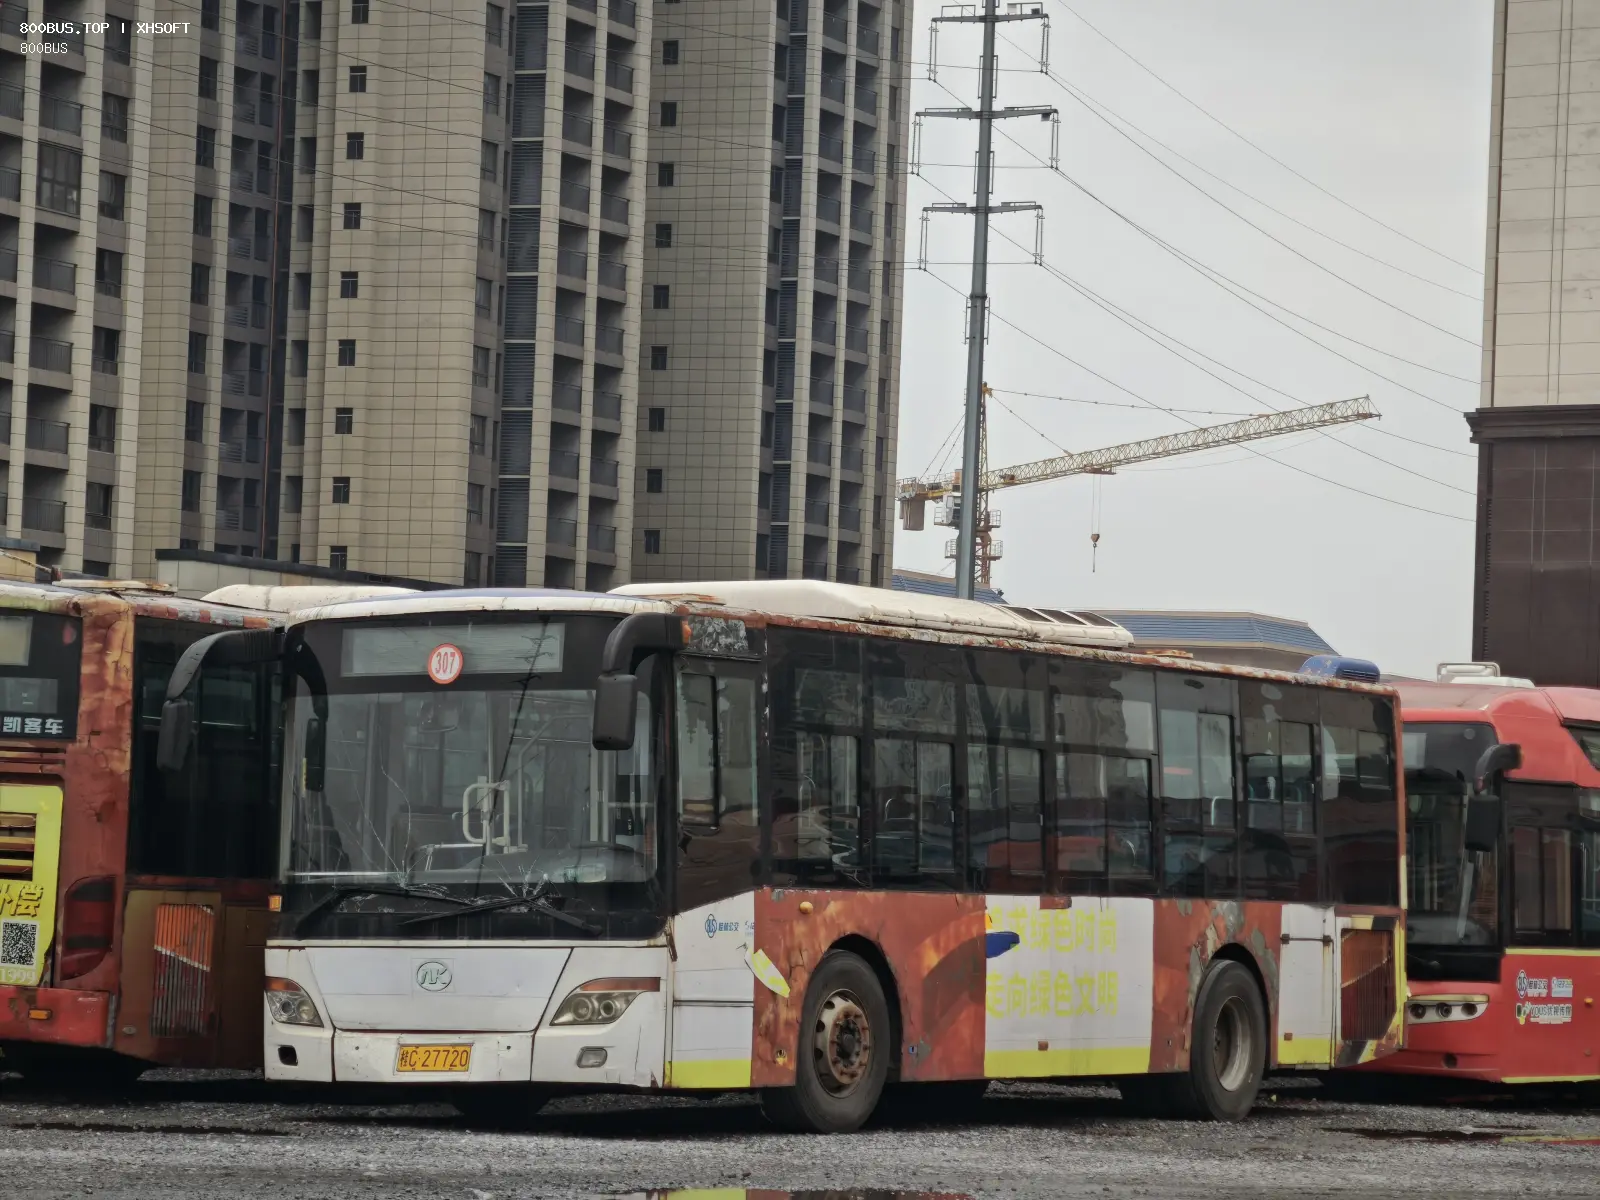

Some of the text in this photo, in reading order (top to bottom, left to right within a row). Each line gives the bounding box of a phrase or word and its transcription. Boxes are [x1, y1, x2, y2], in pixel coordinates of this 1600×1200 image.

[435, 651, 456, 674] 307
[2, 716, 64, 735] 凯客车
[985, 968, 1119, 1018] 走向绿色文明
